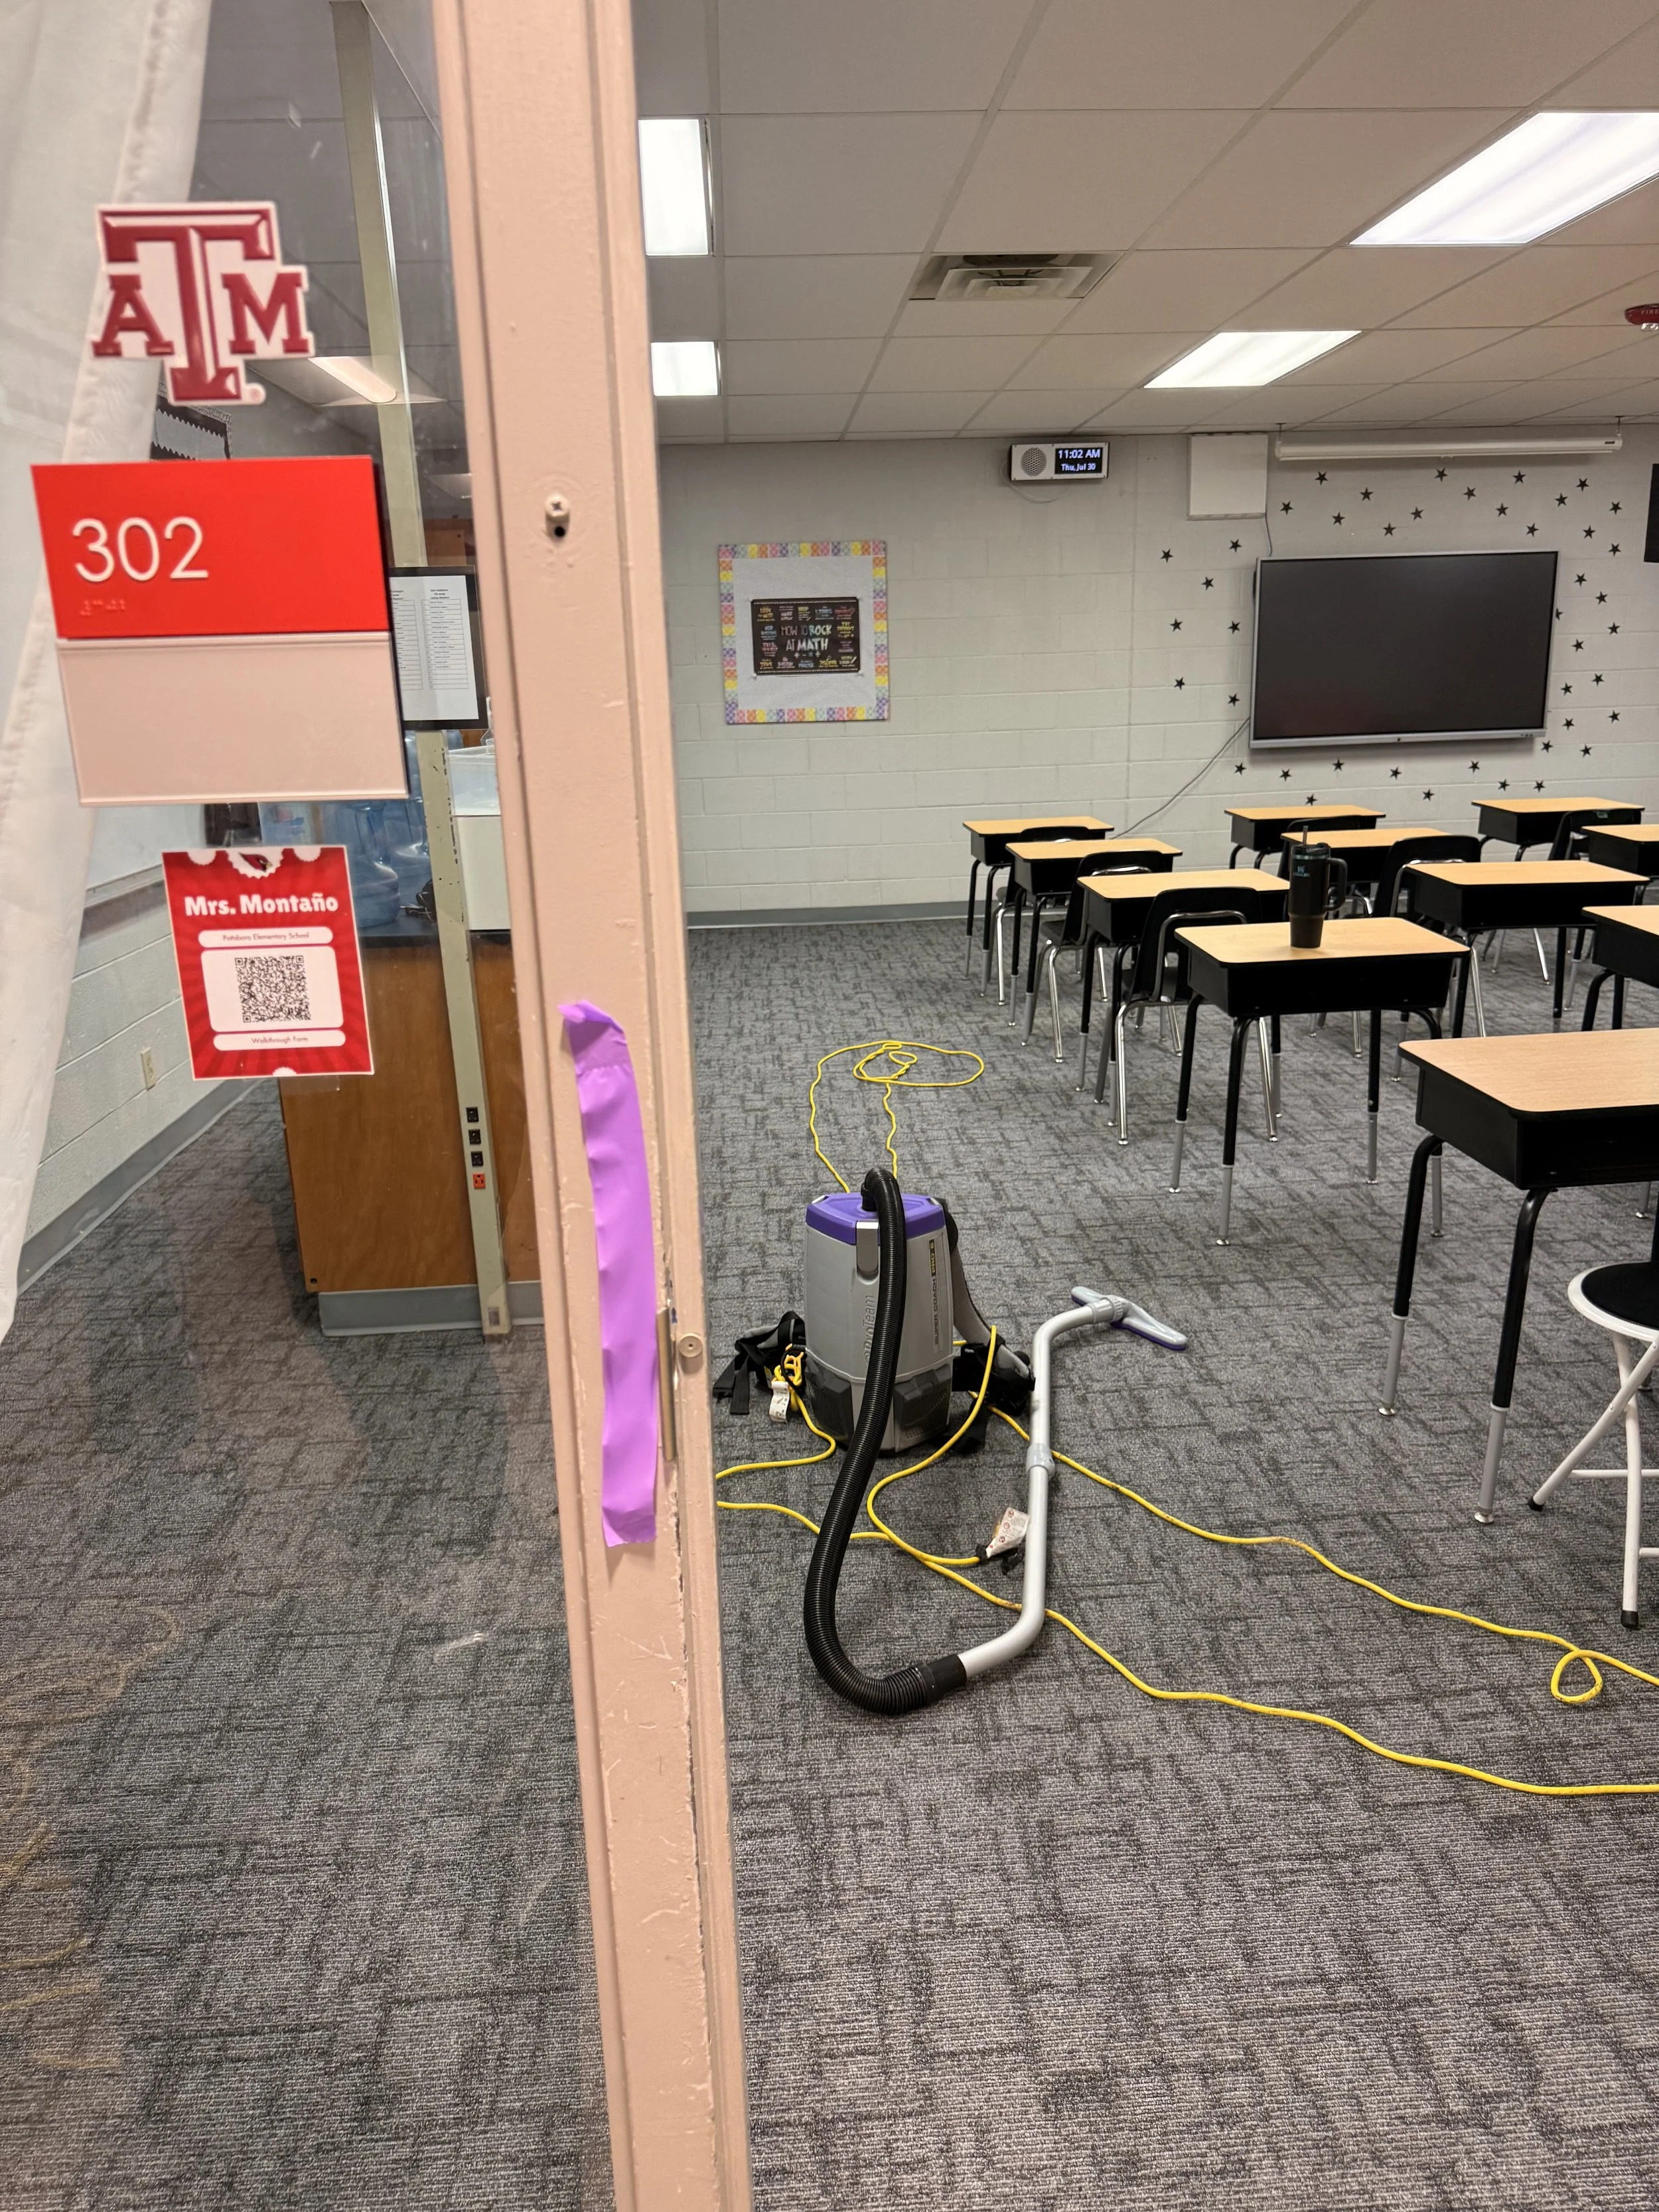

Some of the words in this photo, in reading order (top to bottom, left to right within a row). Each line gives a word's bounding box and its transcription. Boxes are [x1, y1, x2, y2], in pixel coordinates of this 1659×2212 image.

[1058, 449, 1084, 459] 11:02
[1085, 449, 1101, 458] AM
[72, 516, 209, 582] 302
[780, 626, 798, 636] HOW
[800, 625, 808, 636] TO
[809, 625, 831, 636] ROCK
[786, 638, 795, 651] AT
[797, 638, 829, 651] MATH
[184, 896, 236, 917] Mrs.
[240, 893, 338, 915] Montaño
